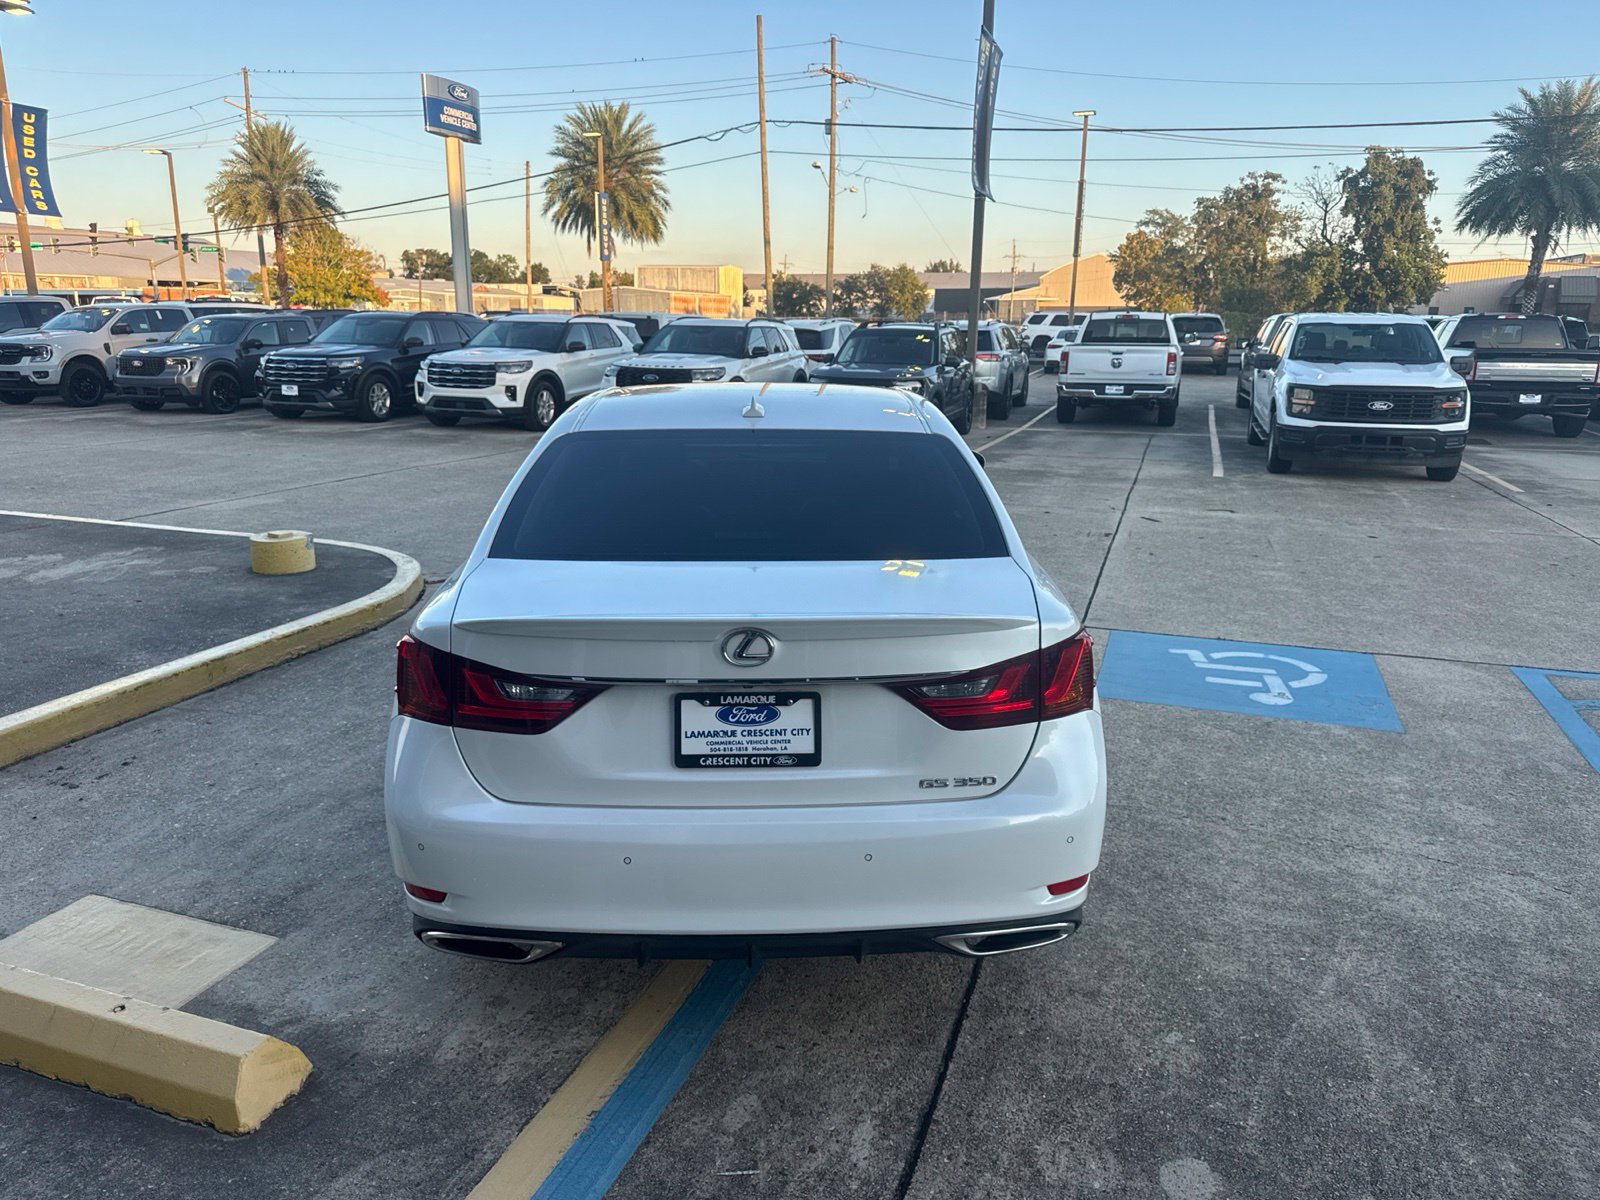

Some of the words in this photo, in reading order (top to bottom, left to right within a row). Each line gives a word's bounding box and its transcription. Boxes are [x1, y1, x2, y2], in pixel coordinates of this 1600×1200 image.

[454, 86, 468, 98] Ford
[23, 112, 36, 159] USED
[25, 166, 49, 211] CARS
[720, 695, 776, 704] LAMARQUE
[728, 705, 767, 722] Ford
[684, 730, 738, 739] LAMARQUE
[740, 728, 788, 738] CRESCENT
[790, 728, 812, 737] CITY
[699, 756, 749, 766] CRESCENT
[750, 756, 773, 765] CITY
[918, 777, 950, 789] GS
[952, 776, 997, 788] 350
